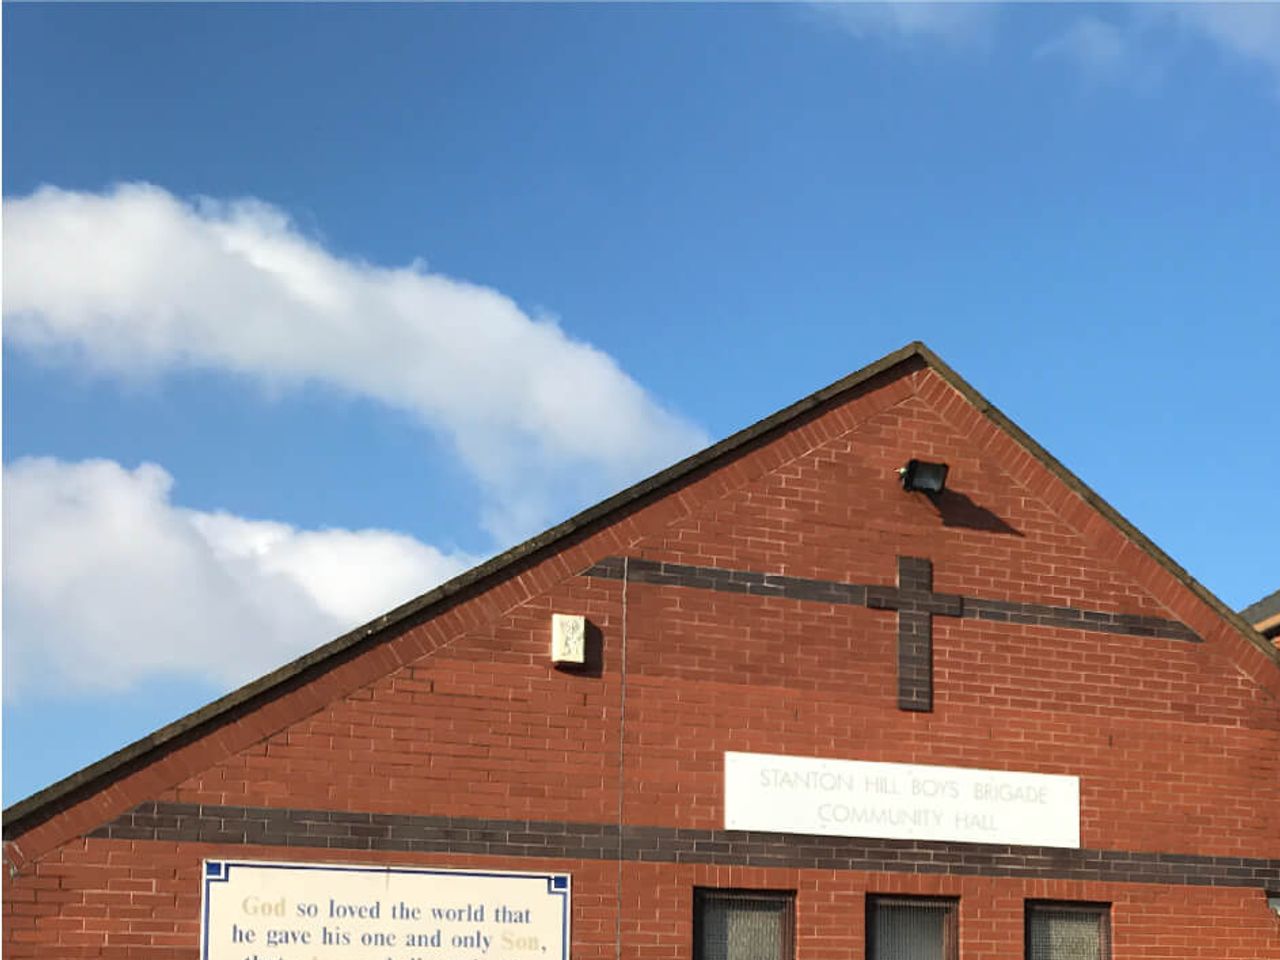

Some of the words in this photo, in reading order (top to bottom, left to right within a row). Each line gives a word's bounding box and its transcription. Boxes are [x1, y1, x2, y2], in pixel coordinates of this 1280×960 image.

[759, 768, 855, 793] STANTON
[864, 775, 901, 795] HILL
[972, 782, 1049, 805] BRIGADE
[816, 803, 945, 828] COMMUNITY
[954, 812, 998, 832] HALL
[241, 896, 287, 917] God
[296, 902, 318, 917] so
[329, 899, 380, 919] loved
[391, 902, 421, 921] the
[431, 904, 485, 922] world
[494, 905, 531, 924] that
[232, 923, 256, 943] he
[266, 928, 311, 946] gave
[322, 926, 351, 945] his
[361, 931, 396, 947] one
[405, 929, 441, 947] and
[451, 930, 493, 953] only
[501, 931, 547, 953] Son,
